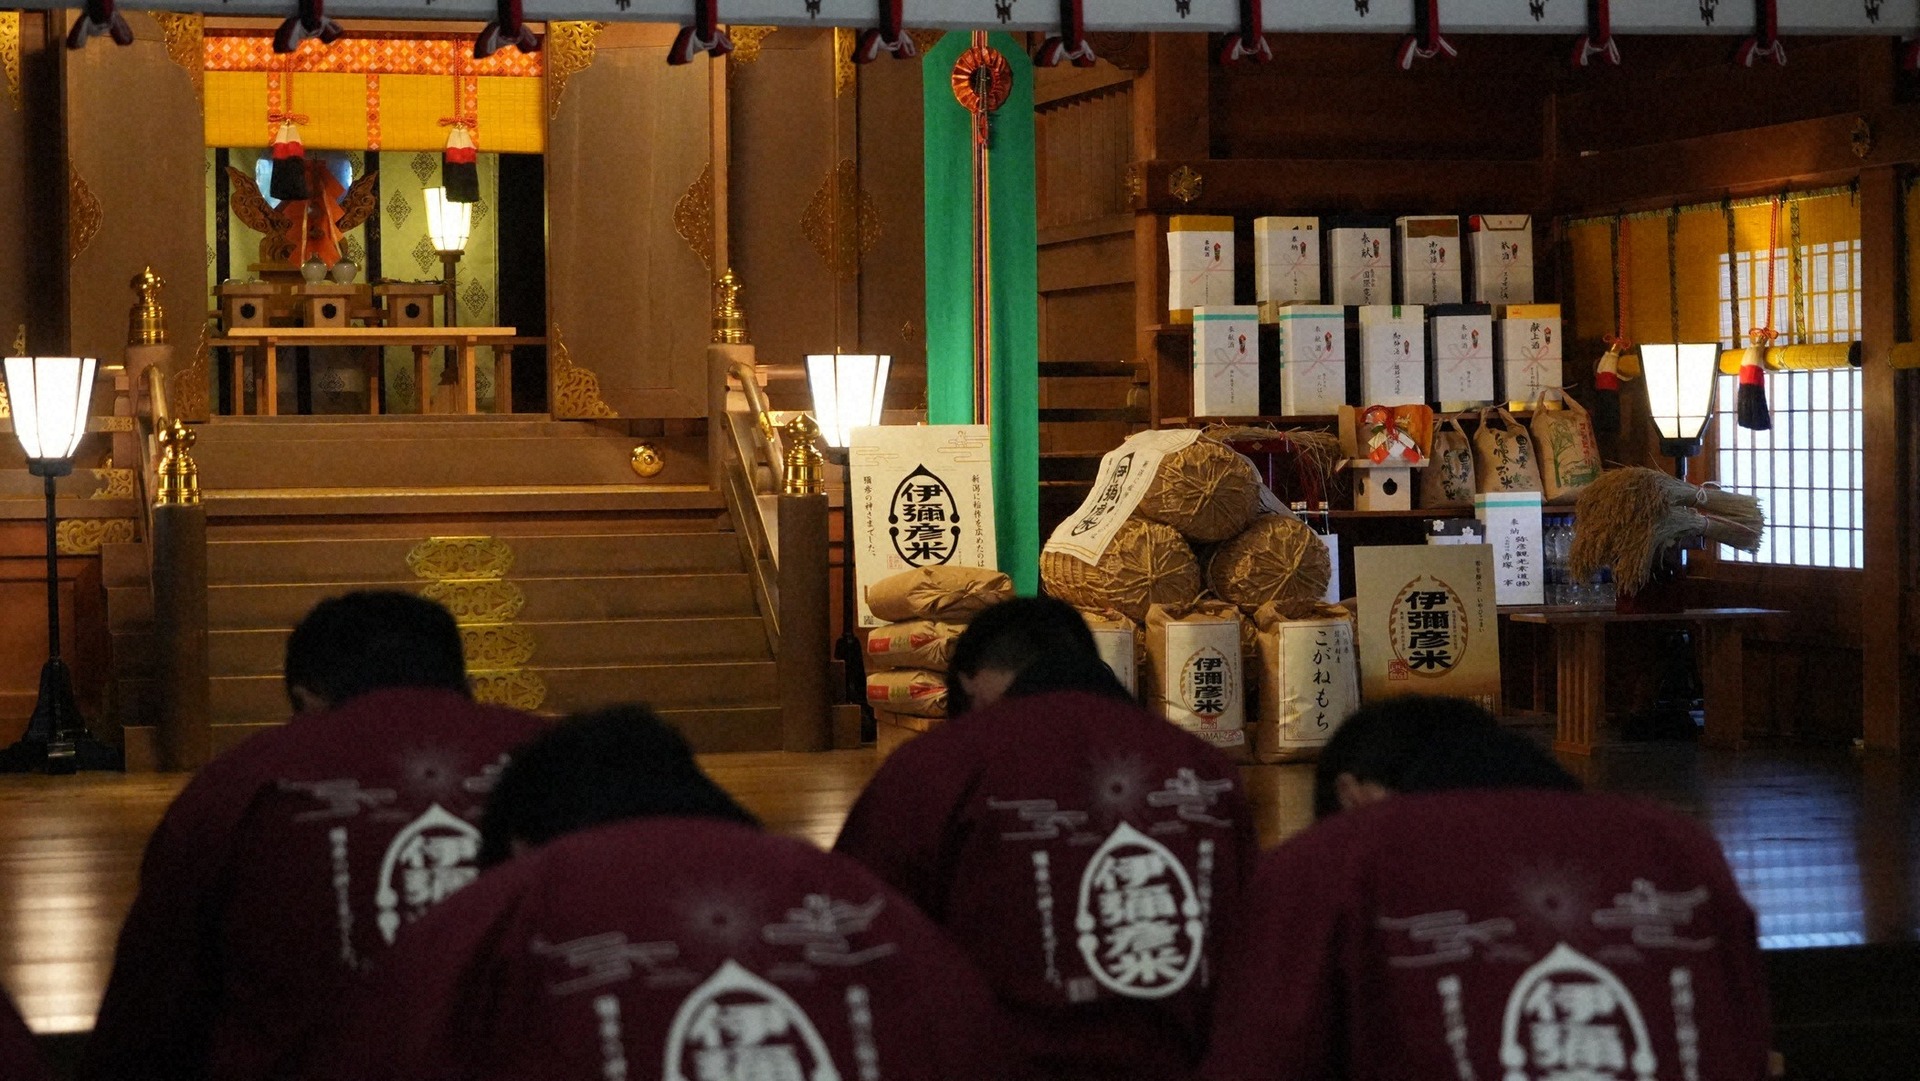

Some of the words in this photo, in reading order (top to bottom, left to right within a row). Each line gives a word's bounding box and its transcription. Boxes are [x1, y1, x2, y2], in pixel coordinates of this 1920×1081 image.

[1530, 322, 1541, 350] 献上酒
[901, 482, 948, 560] 伊彌彦米
[972, 474, 985, 567] 新潟に稲作を広めたのは
[1405, 591, 1453, 669] 伊彌彦米
[1193, 658, 1223, 712] 伊彌彦米
[1312, 630, 1331, 731] こがねもち
